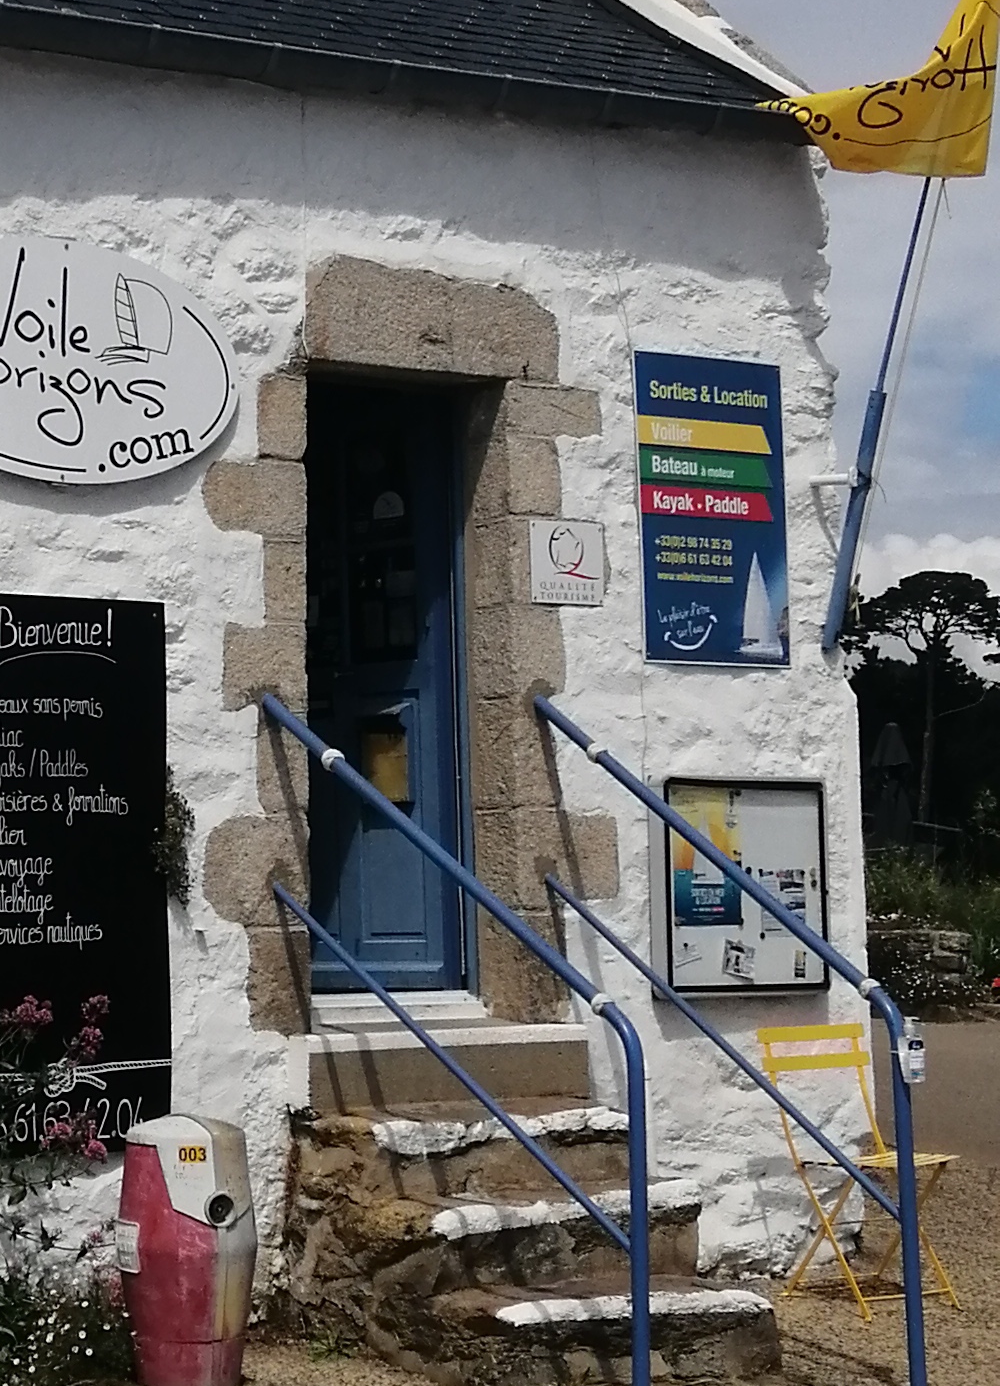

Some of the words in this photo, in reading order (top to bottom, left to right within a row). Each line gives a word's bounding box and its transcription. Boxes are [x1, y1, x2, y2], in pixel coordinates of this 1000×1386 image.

[649, 380, 698, 402] Sorties
[700, 385, 711, 403] &
[713, 386, 768, 409] Location
[651, 422, 693, 442] Voilier
[98, 426, 195, 473] .com
[651, 455, 698, 476] Bateau
[700, 465, 706, 477] à
[707, 468, 735, 479] moteur
[653, 491, 694, 514] Kayak
[705, 494, 749, 515] Paddle
[699, 537, 709, 548] 74
[710, 538, 721, 549] 35
[687, 553, 697, 565] 61
[699, 553, 710, 565] 63
[711, 554, 721, 566] 42
[722, 555, 733, 566] 04
[540, 592, 595, 602] TOURISME
[33, 698, 61, 714] sans
[63, 698, 103, 722] permis
[40, 749, 89, 777] Paddles
[52, 793, 64, 812] &
[66, 784, 129, 826] formations
[47, 912, 103, 951] nautiques
[178, 1147, 207, 1162] 003
